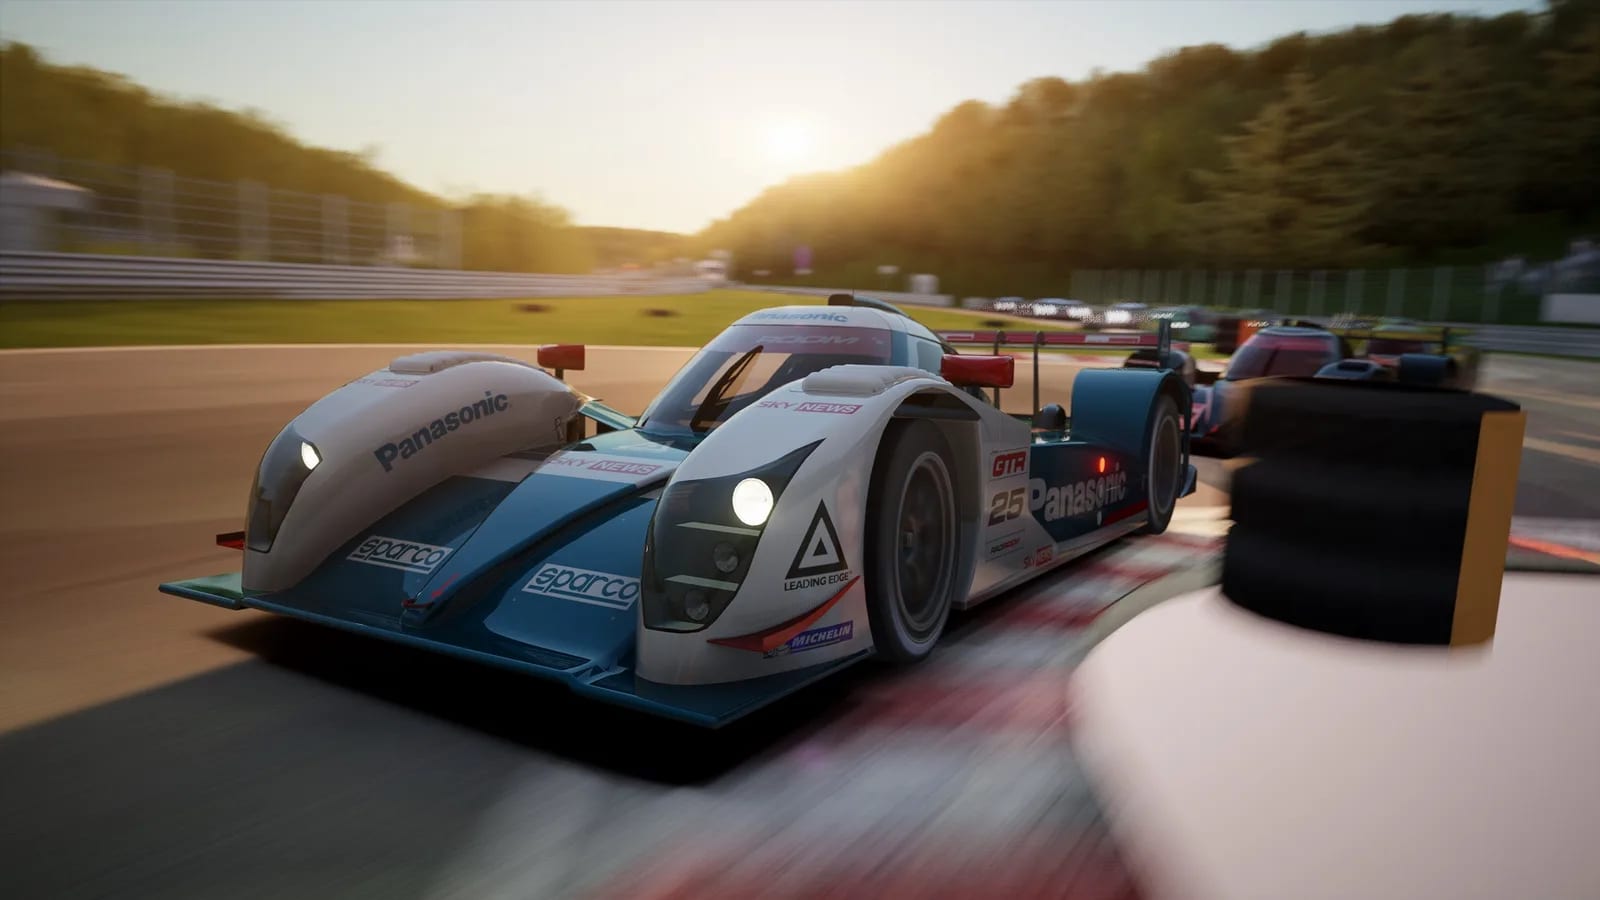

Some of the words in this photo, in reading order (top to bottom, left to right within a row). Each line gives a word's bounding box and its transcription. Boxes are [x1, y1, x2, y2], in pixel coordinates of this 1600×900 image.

[757, 401, 794, 409] SKY
[799, 403, 857, 413] NEWS
[374, 391, 508, 472] Panasonic
[596, 461, 653, 474] NEWS
[1028, 462, 1127, 521] Panasonic
[988, 487, 1025, 527] 25
[359, 538, 443, 563] sparco
[535, 566, 640, 601] sparco
[784, 577, 826, 591] LEADING
[829, 571, 848, 584] EDGE
[792, 624, 851, 647] MICHELIN
